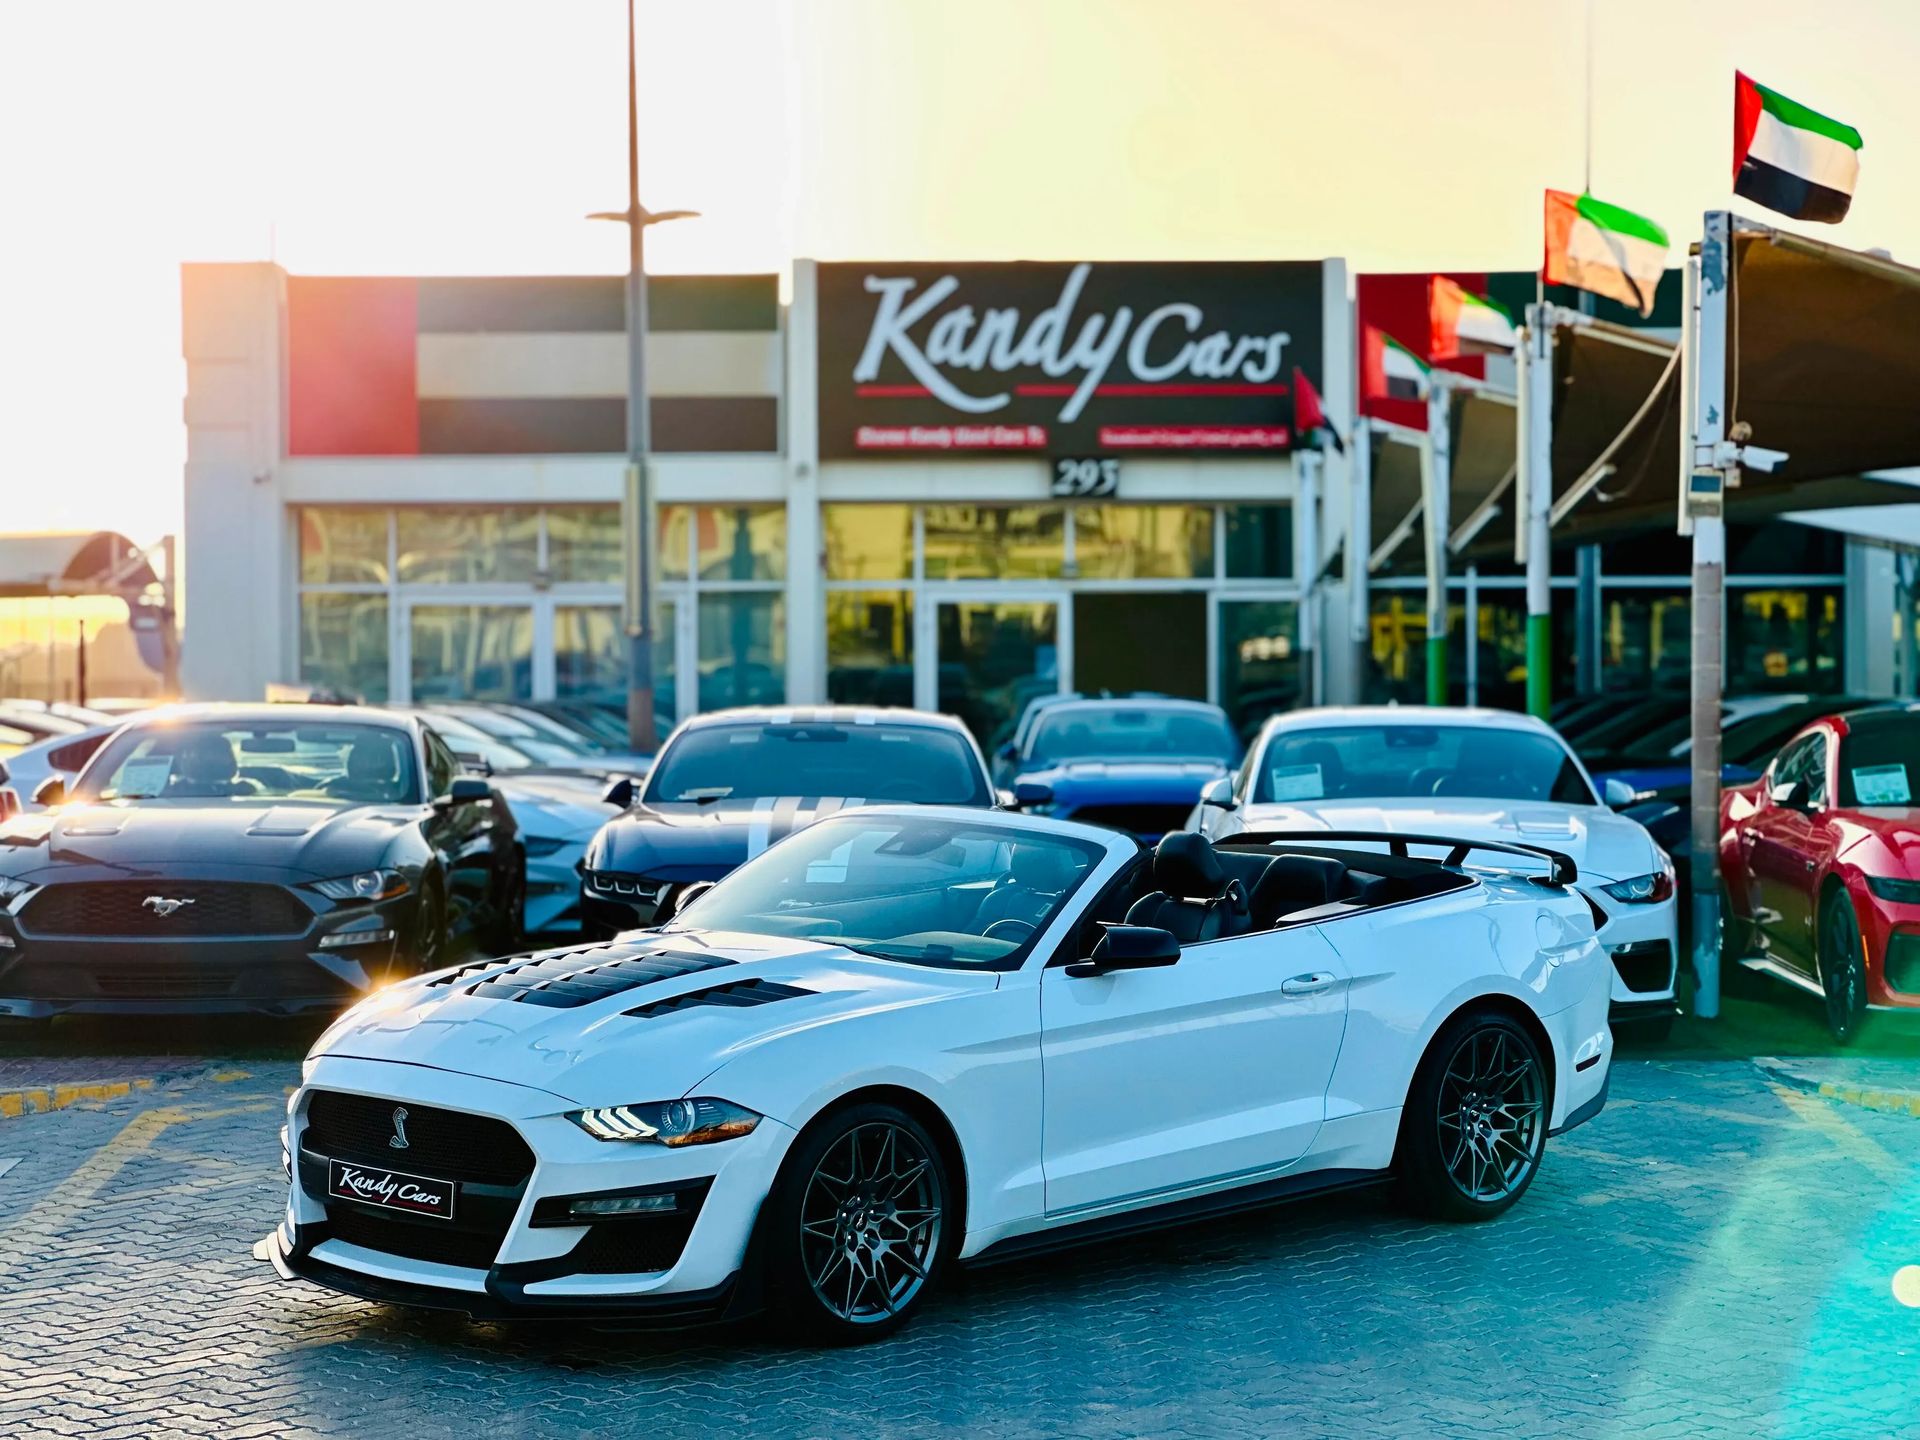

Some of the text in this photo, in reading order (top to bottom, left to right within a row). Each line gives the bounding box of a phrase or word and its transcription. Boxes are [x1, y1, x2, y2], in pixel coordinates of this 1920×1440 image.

[854, 263, 1290, 422] Kandy Cars
[1053, 459, 1119, 495] 295
[339, 1167, 441, 1205] Kandy Cars
